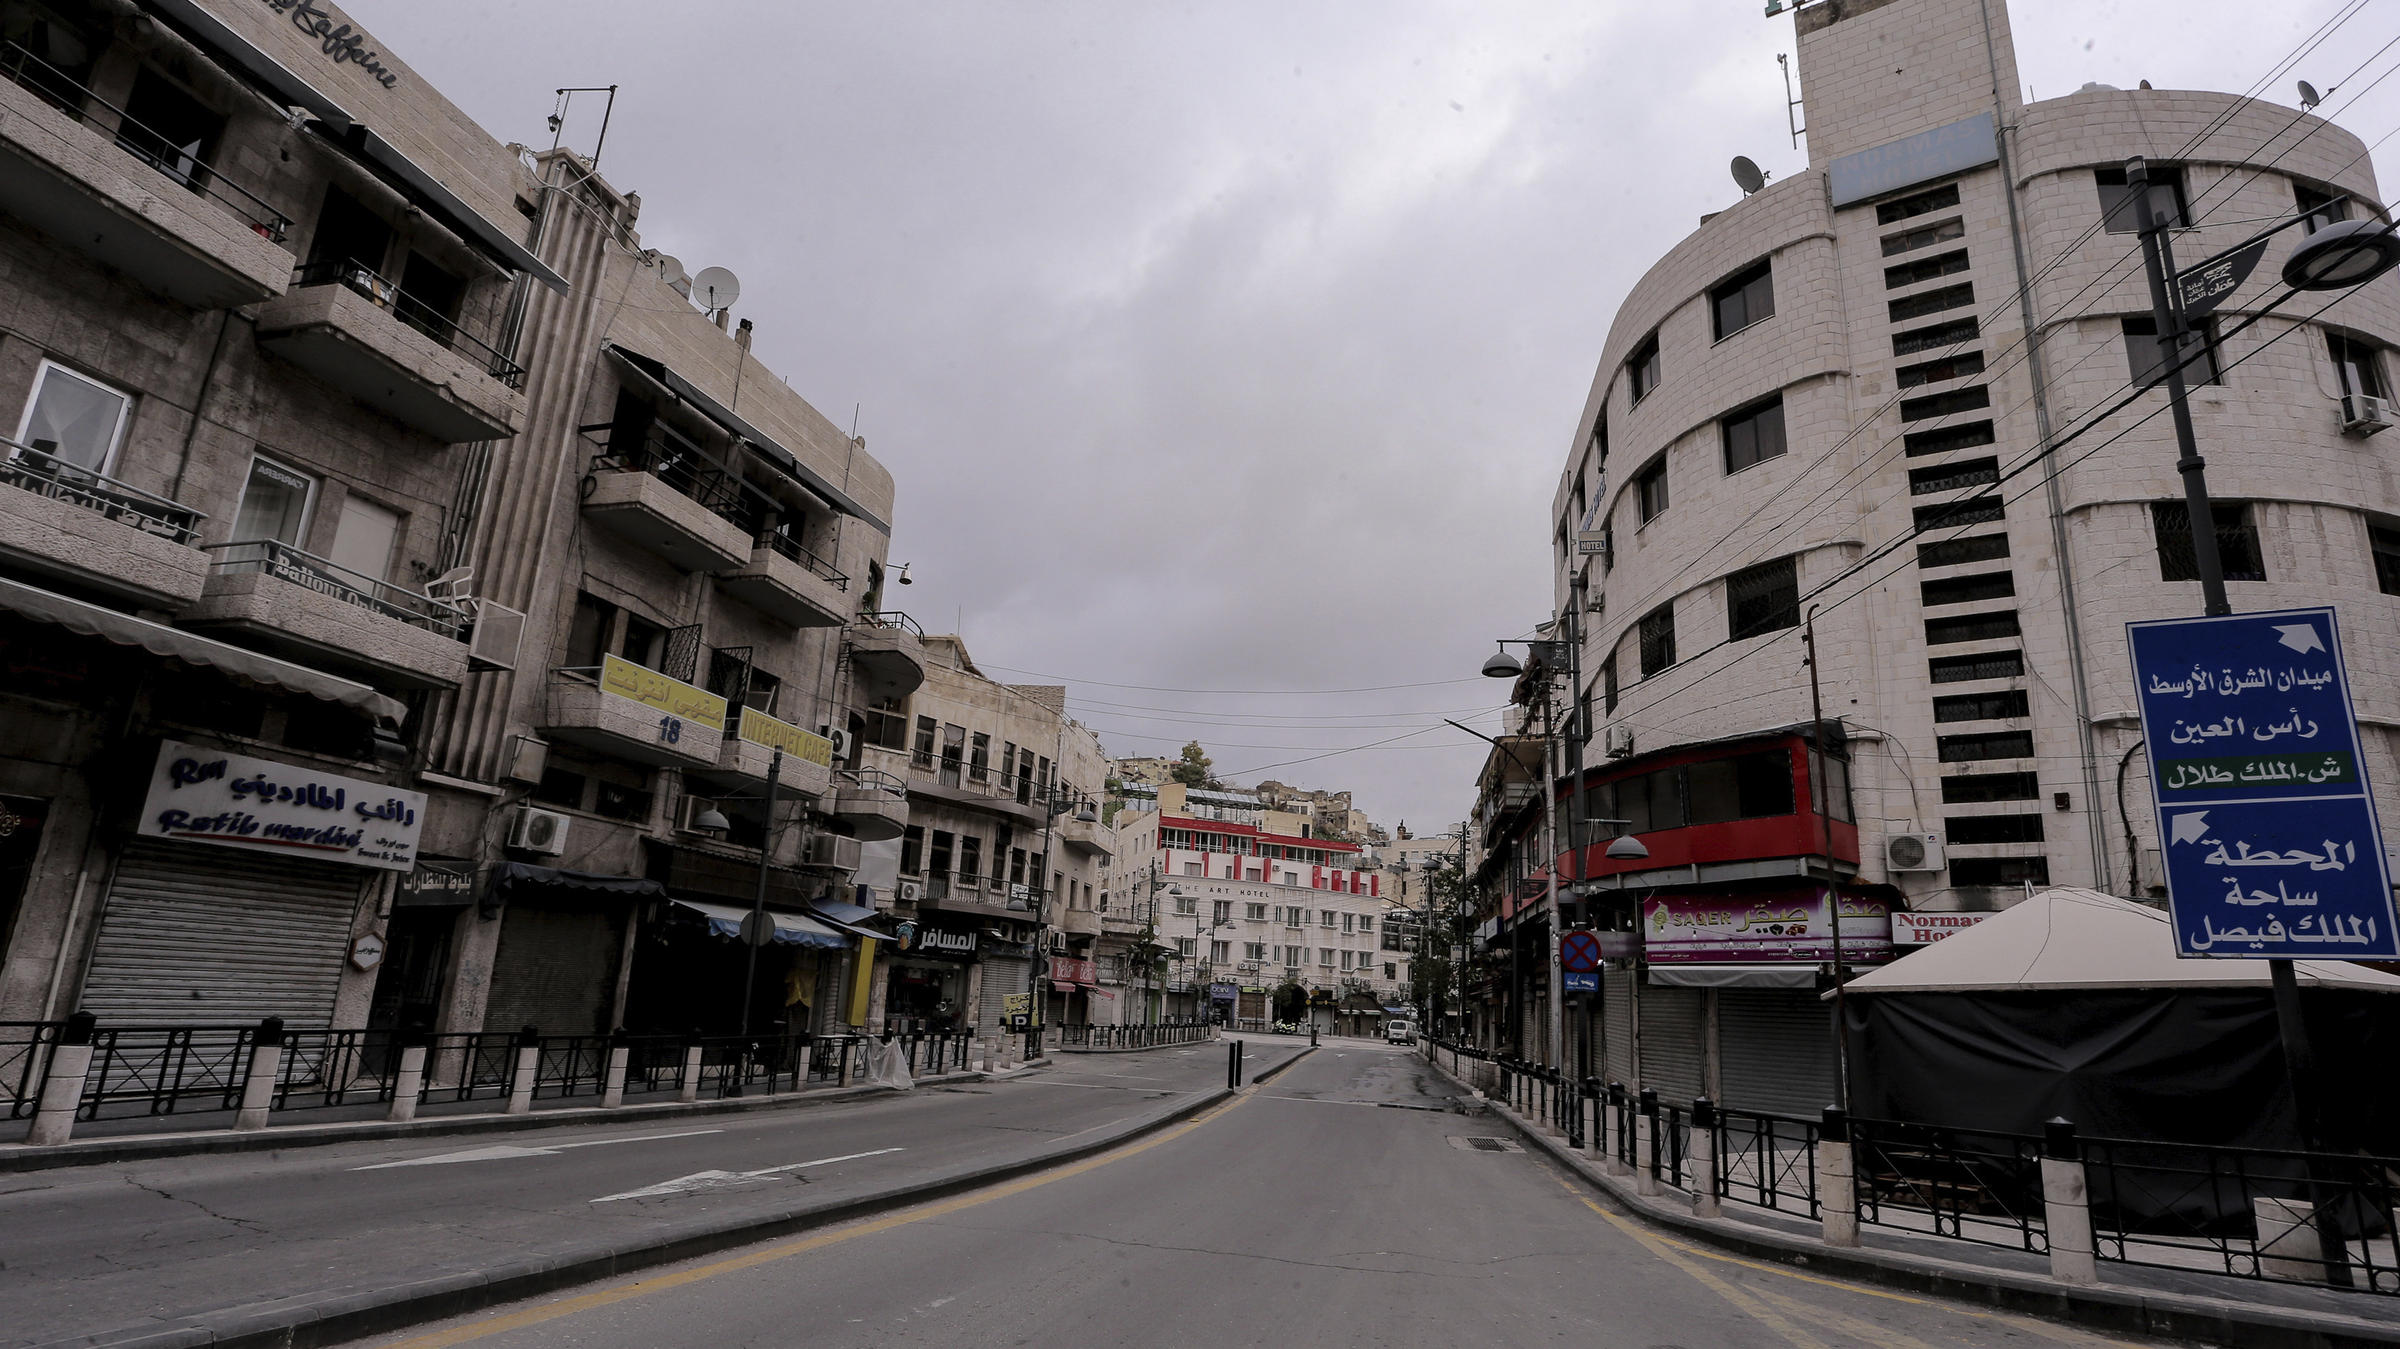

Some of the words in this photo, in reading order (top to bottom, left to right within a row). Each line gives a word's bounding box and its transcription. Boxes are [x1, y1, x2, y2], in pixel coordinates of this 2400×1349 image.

[293, 0, 398, 89] Kaffeine
[1580, 541, 1605, 550] HOTEL
[2150, 664, 2213, 698] الأوسط
[2219, 668, 2272, 695] الشرق
[2278, 668, 2331, 691] ميدان
[660, 716, 681, 744] 18
[2171, 717, 2244, 743] العين
[2254, 708, 2318, 740] رأس
[2169, 765, 2233, 788] طلال
[230, 774, 345, 811] المارديني
[2201, 839, 2354, 871] المحطة
[1240, 889, 1269, 898] HOTEL
[2223, 877, 2317, 905] ساحة
[1673, 911, 1732, 928] SAQER
[1736, 904, 1808, 933] صقر
[1897, 913, 1984, 928] Normas
[2191, 914, 2285, 950] فيصل
[2289, 915, 2376, 944] الملك
[918, 928, 977, 952] المسافر
[1015, 1016, 1028, 1031] P
